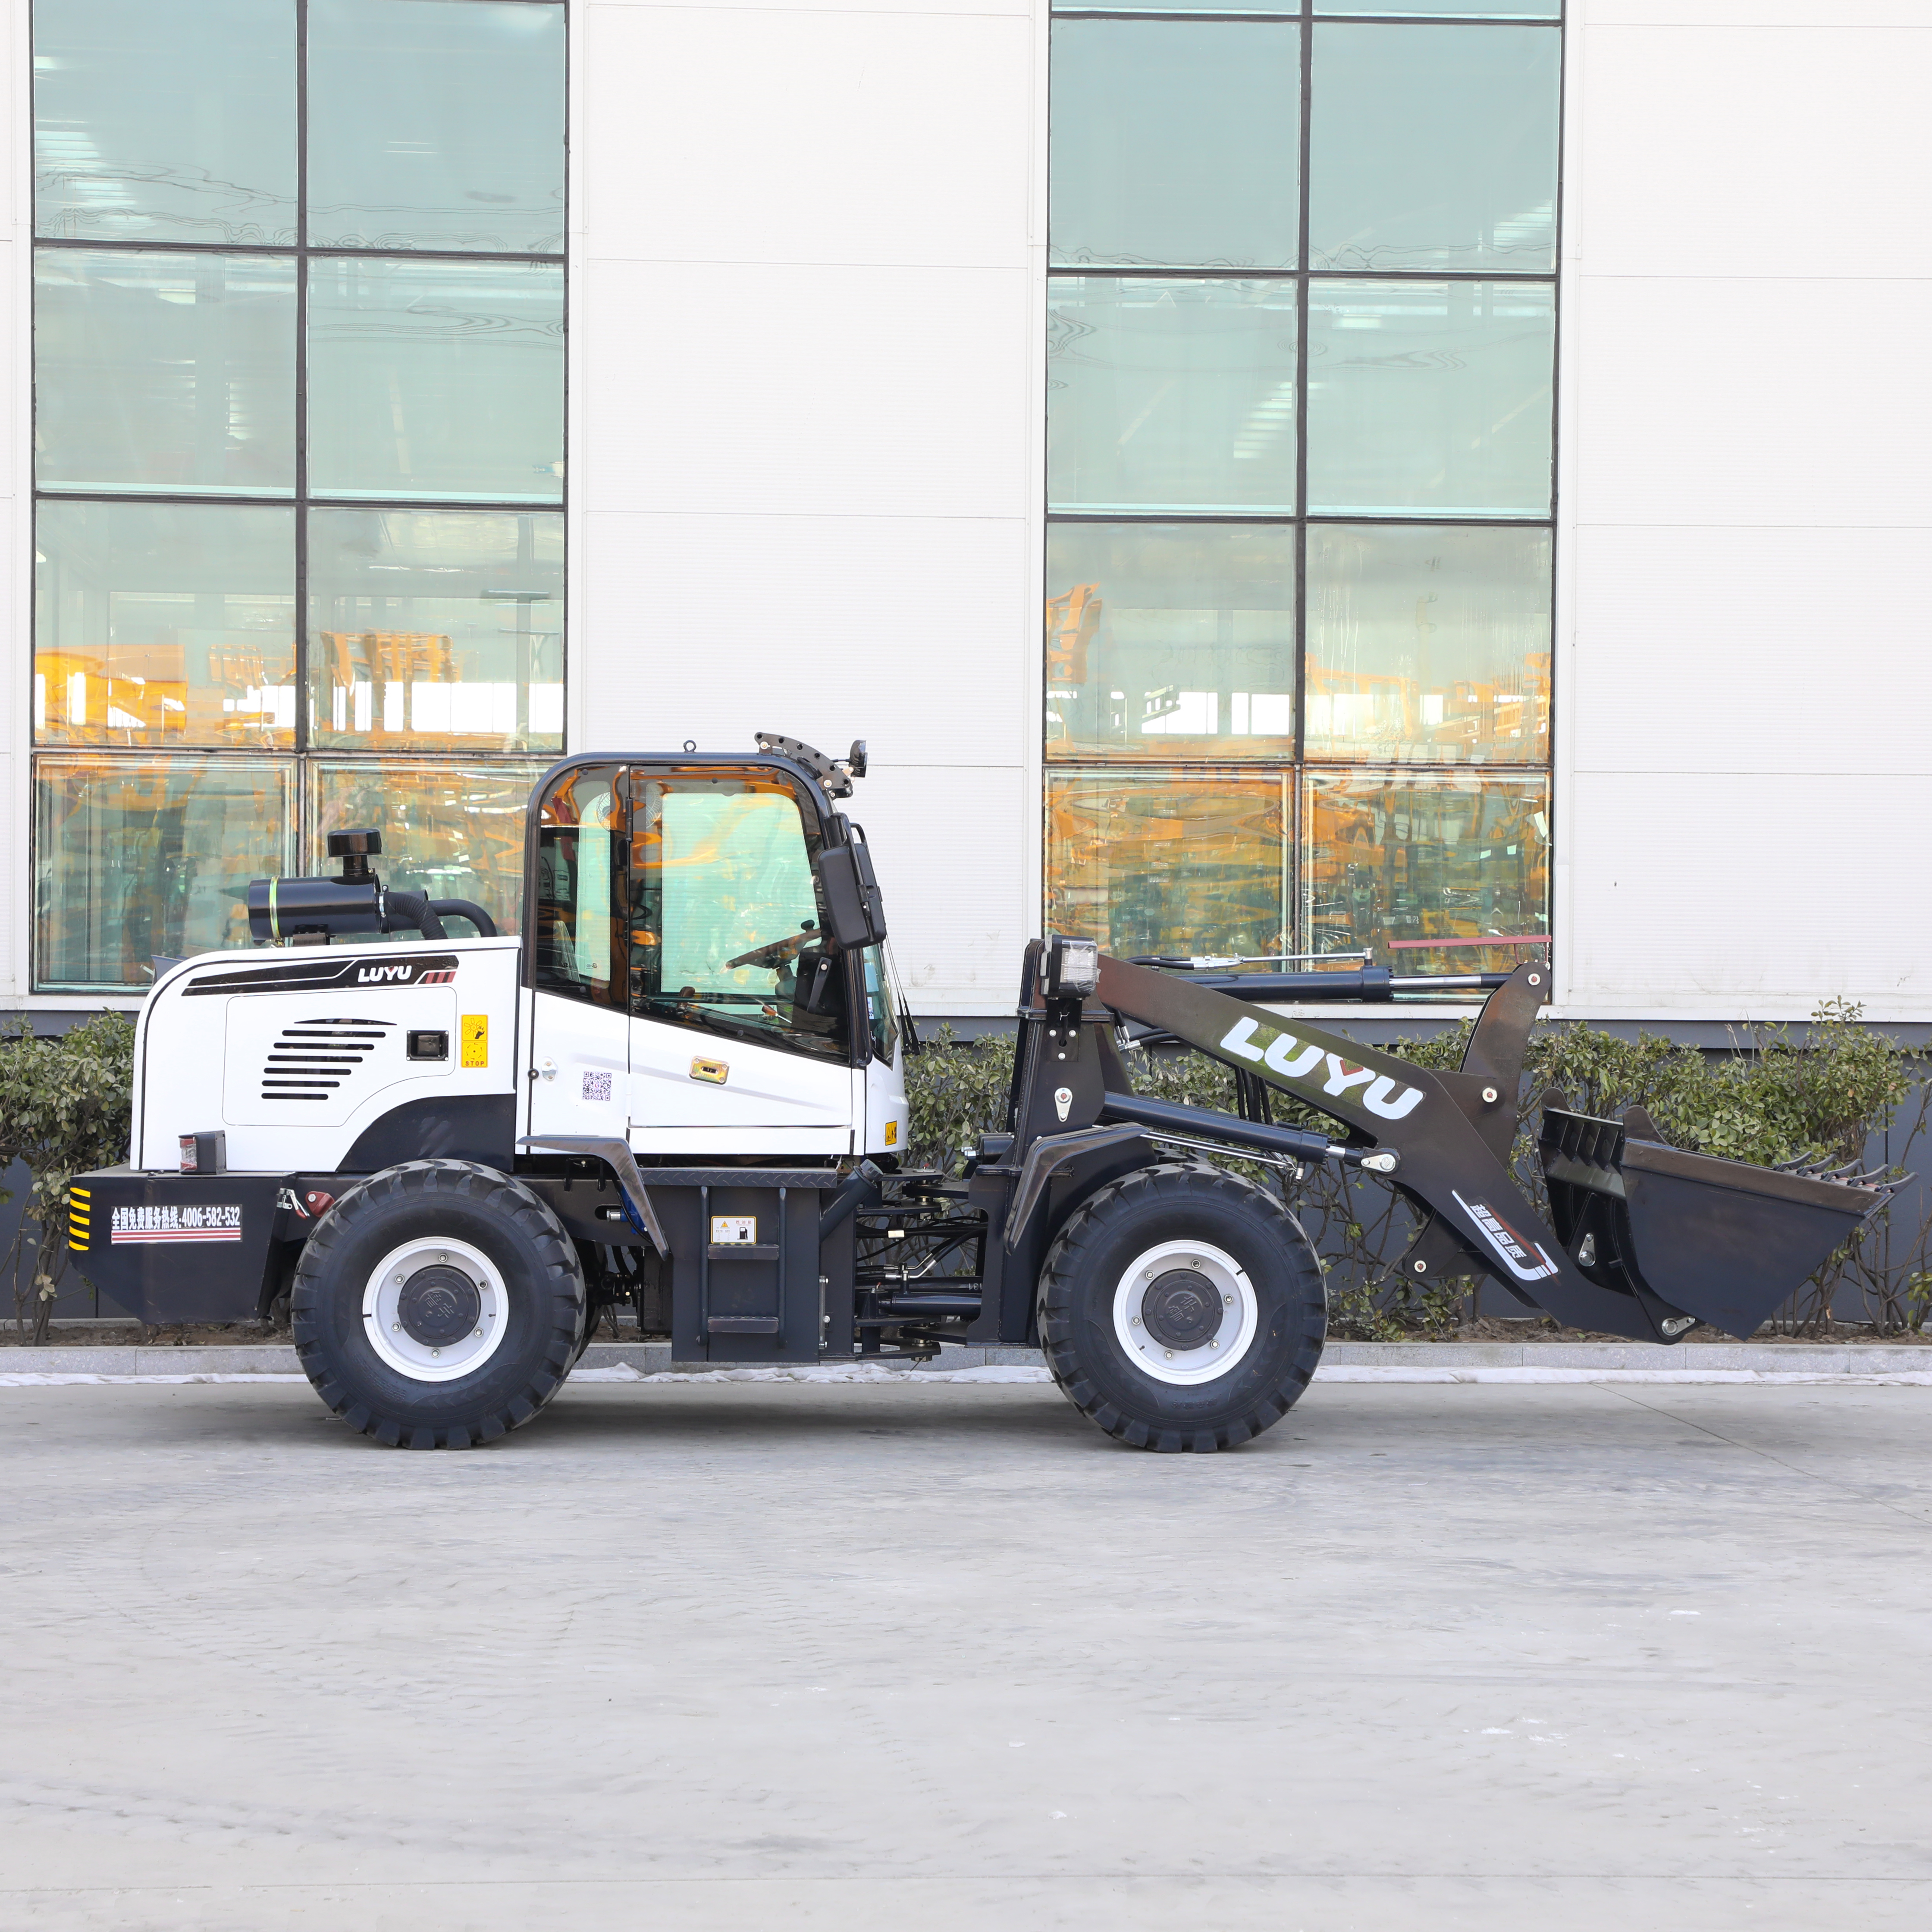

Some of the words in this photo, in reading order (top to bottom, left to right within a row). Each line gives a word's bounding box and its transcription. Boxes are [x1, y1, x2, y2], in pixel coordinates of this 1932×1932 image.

[358, 965, 412, 982] LUYU
[1220, 1016, 1423, 1120] LUYU
[1470, 1204, 1527, 1258] 超高品质
